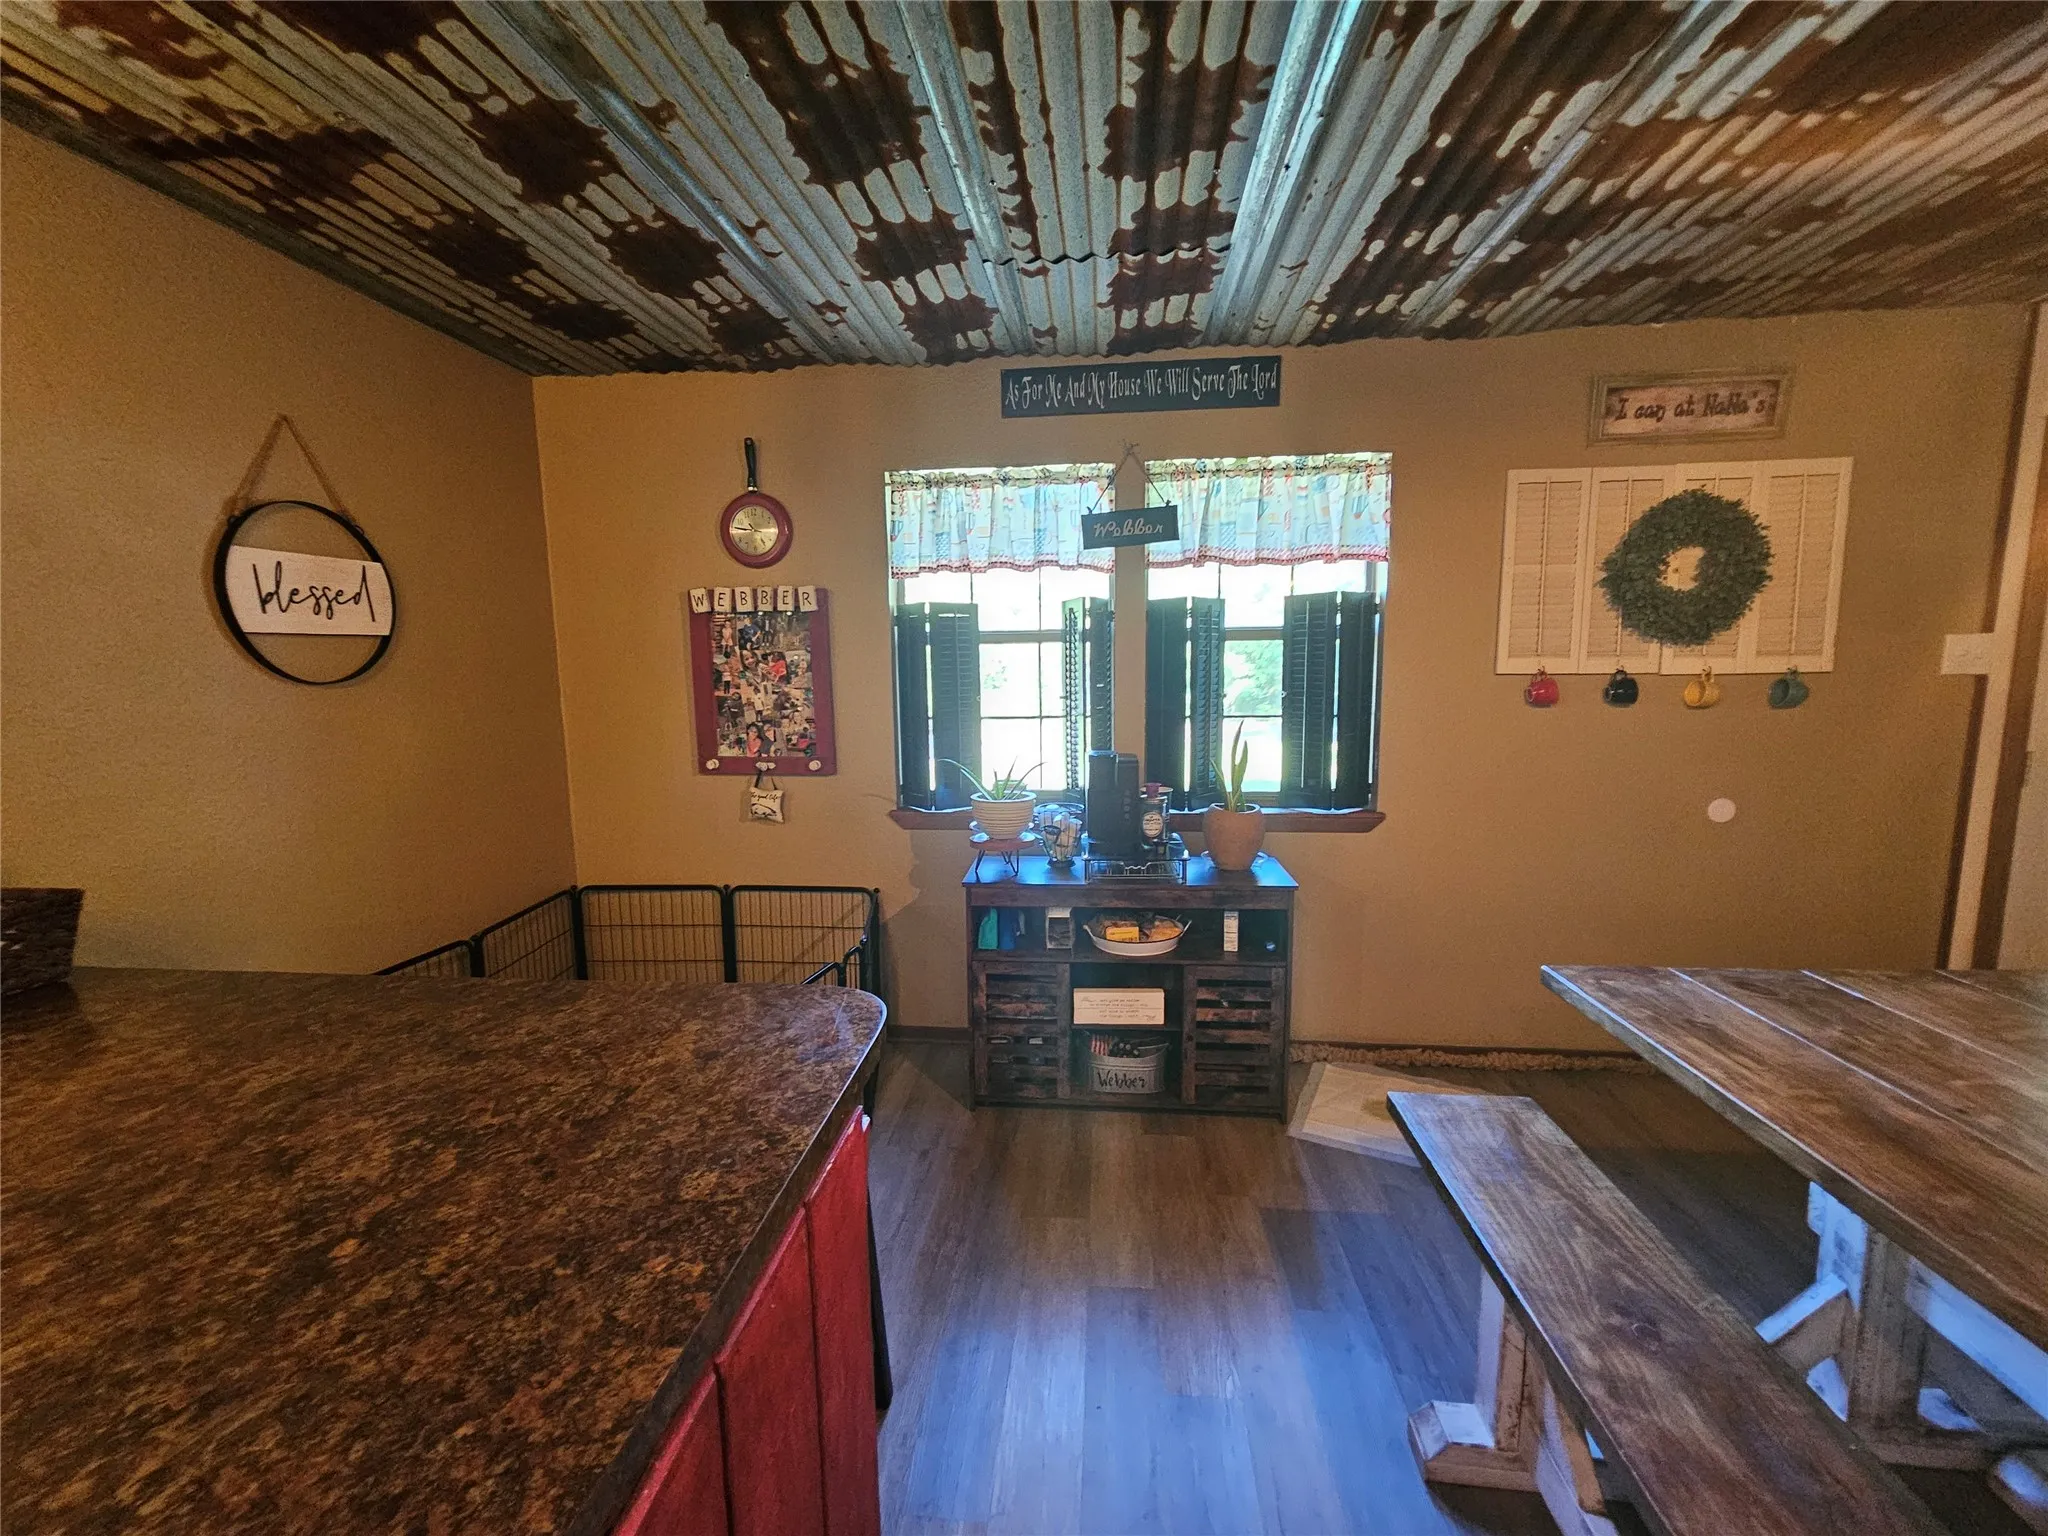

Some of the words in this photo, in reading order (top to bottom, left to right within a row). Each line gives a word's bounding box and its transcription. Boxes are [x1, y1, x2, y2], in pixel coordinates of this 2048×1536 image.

[1005, 378, 1019, 410] As
[1022, 376, 1042, 409] For
[1045, 374, 1061, 408] Me
[1065, 372, 1085, 407] And
[1088, 371, 1105, 409] My
[1108, 371, 1141, 399] House
[1144, 369, 1162, 397] We
[1166, 367, 1189, 396] Will
[1192, 366, 1225, 401] Serve
[1228, 364, 1248, 399] The
[1251, 363, 1278, 400] Lord
[1614, 397, 1629, 420] I
[1674, 395, 1695, 418] at
[1093, 518, 1164, 537] Webber
[252, 560, 376, 622] blessed
[693, 590, 812, 608] WEBBER
[1097, 1070, 1146, 1089] Webber
